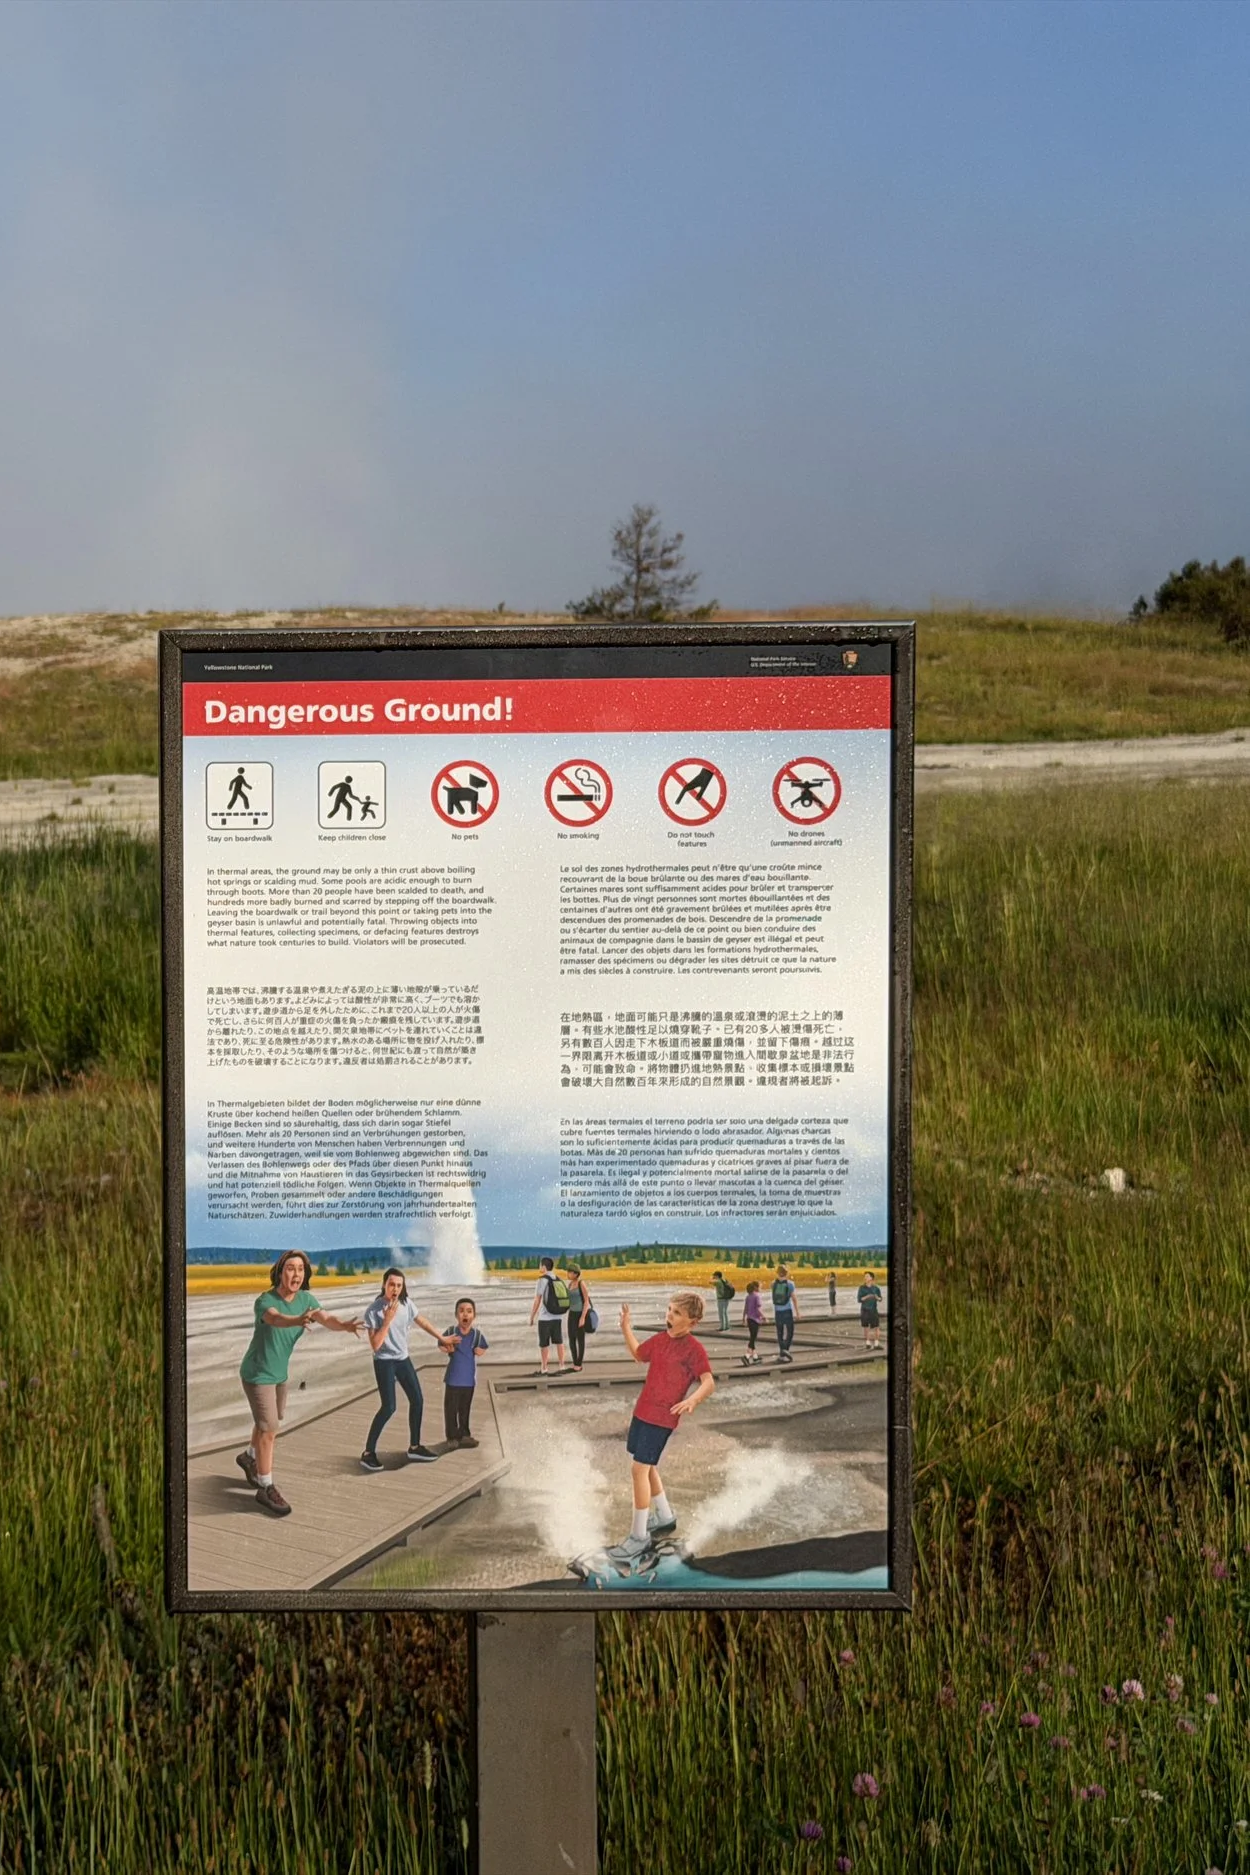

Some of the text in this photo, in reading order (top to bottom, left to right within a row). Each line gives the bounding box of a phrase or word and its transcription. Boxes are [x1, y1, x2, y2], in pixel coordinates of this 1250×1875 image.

[204, 698, 513, 729] Dangerous Ground!
[207, 835, 222, 843] Stay
[318, 834, 336, 843] Keep
[570, 832, 600, 841] smoking
[770, 839, 812, 847] (unmanned
[292, 867, 321, 876] ground
[354, 866, 372, 876] only
[447, 866, 476, 875] boiling
[235, 1108, 254, 1118] über
[256, 1109, 290, 1118] kochend
[292, 1109, 319, 1117] heißen
[322, 1109, 353, 1118] Quellen
[355, 1108, 374, 1117] oder
[376, 1109, 422, 1117] brühendem
[424, 1108, 462, 1117] Schlamm.
